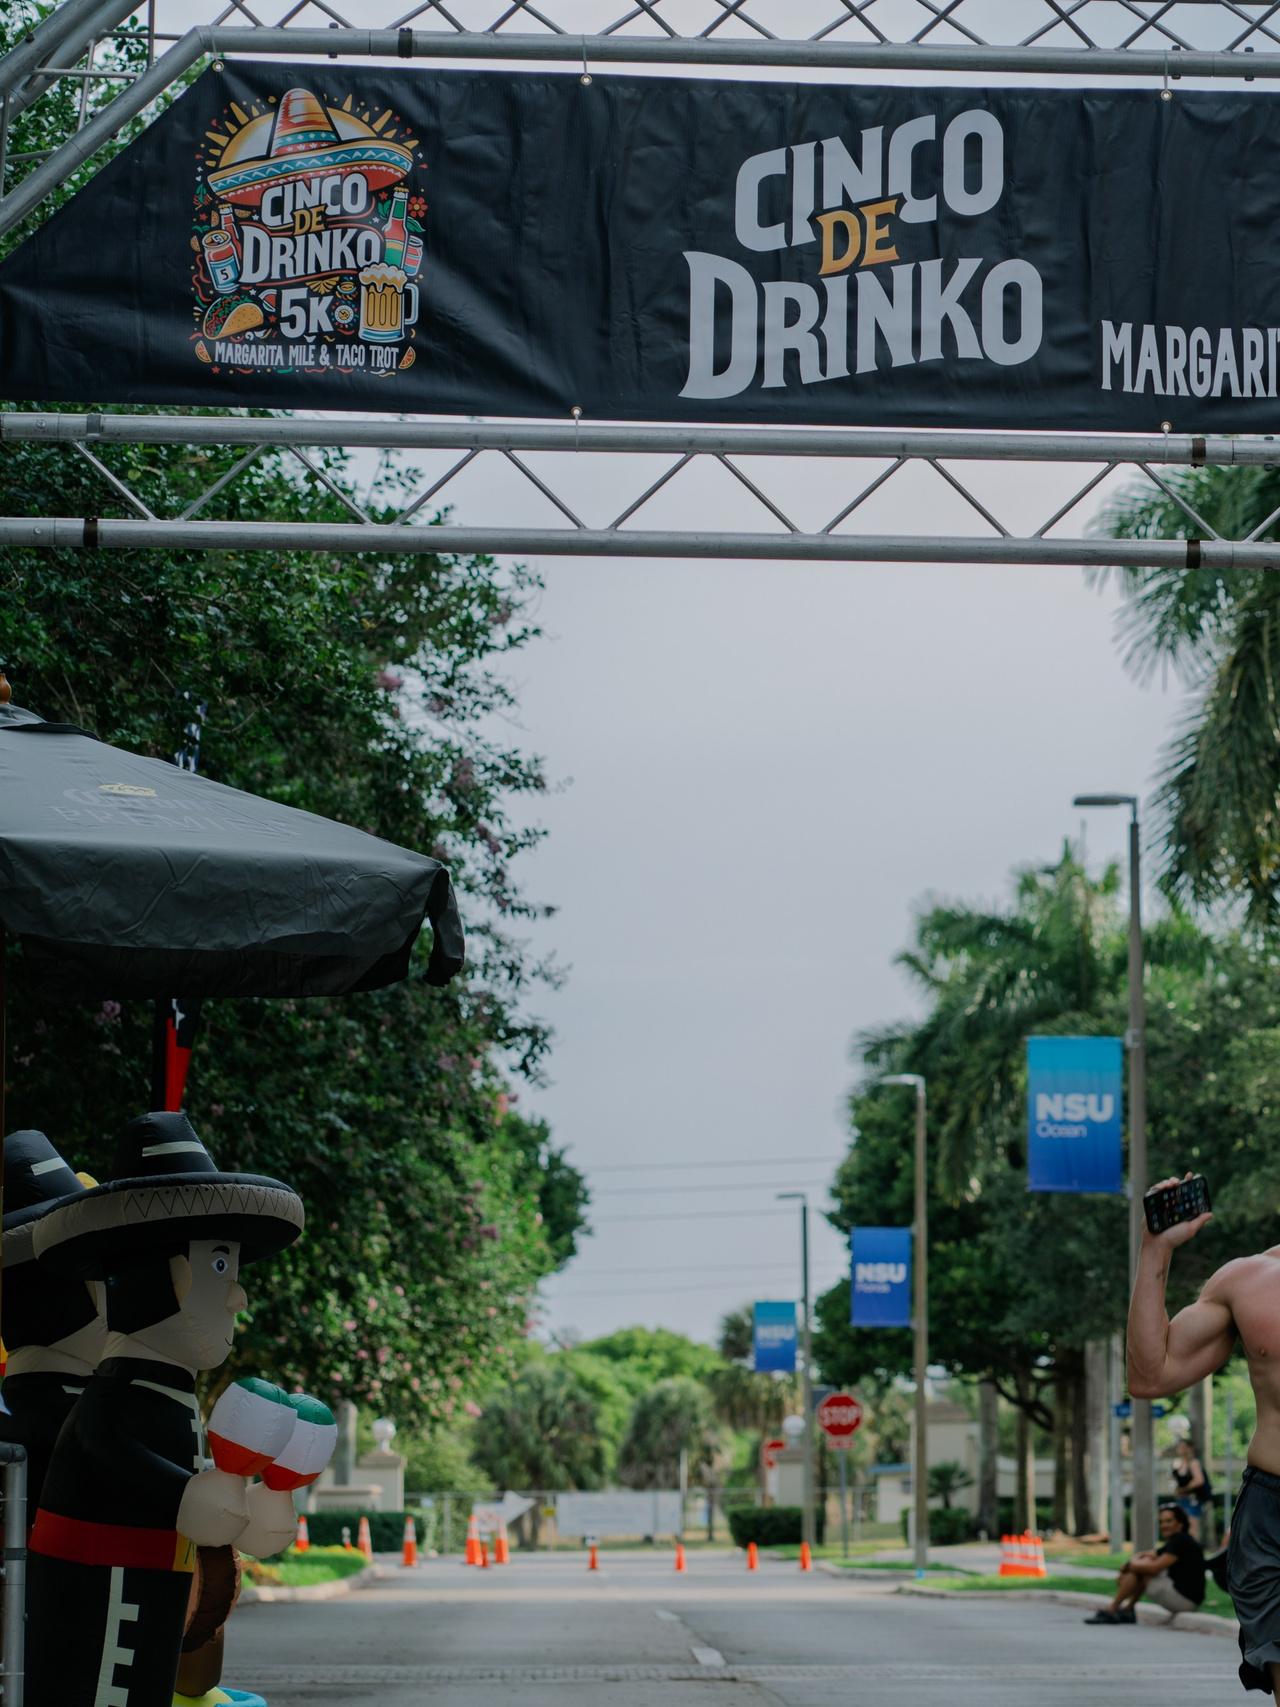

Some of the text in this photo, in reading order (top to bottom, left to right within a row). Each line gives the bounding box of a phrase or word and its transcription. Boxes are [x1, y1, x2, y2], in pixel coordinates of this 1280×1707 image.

[260, 173, 368, 227] CINCO
[735, 109, 1004, 252] CINCO
[293, 205, 326, 234] DE
[816, 199, 900, 275] DE
[238, 225, 382, 284] DRINKO
[280, 288, 334, 338] 5K
[677, 251, 1043, 400] DRINKO
[215, 341, 399, 369] MARGARITA MILE & TACO TROT
[1036, 1093, 1114, 1123] NSU
[855, 1263, 907, 1285] NSU
[819, 1406, 861, 1426] STOP
